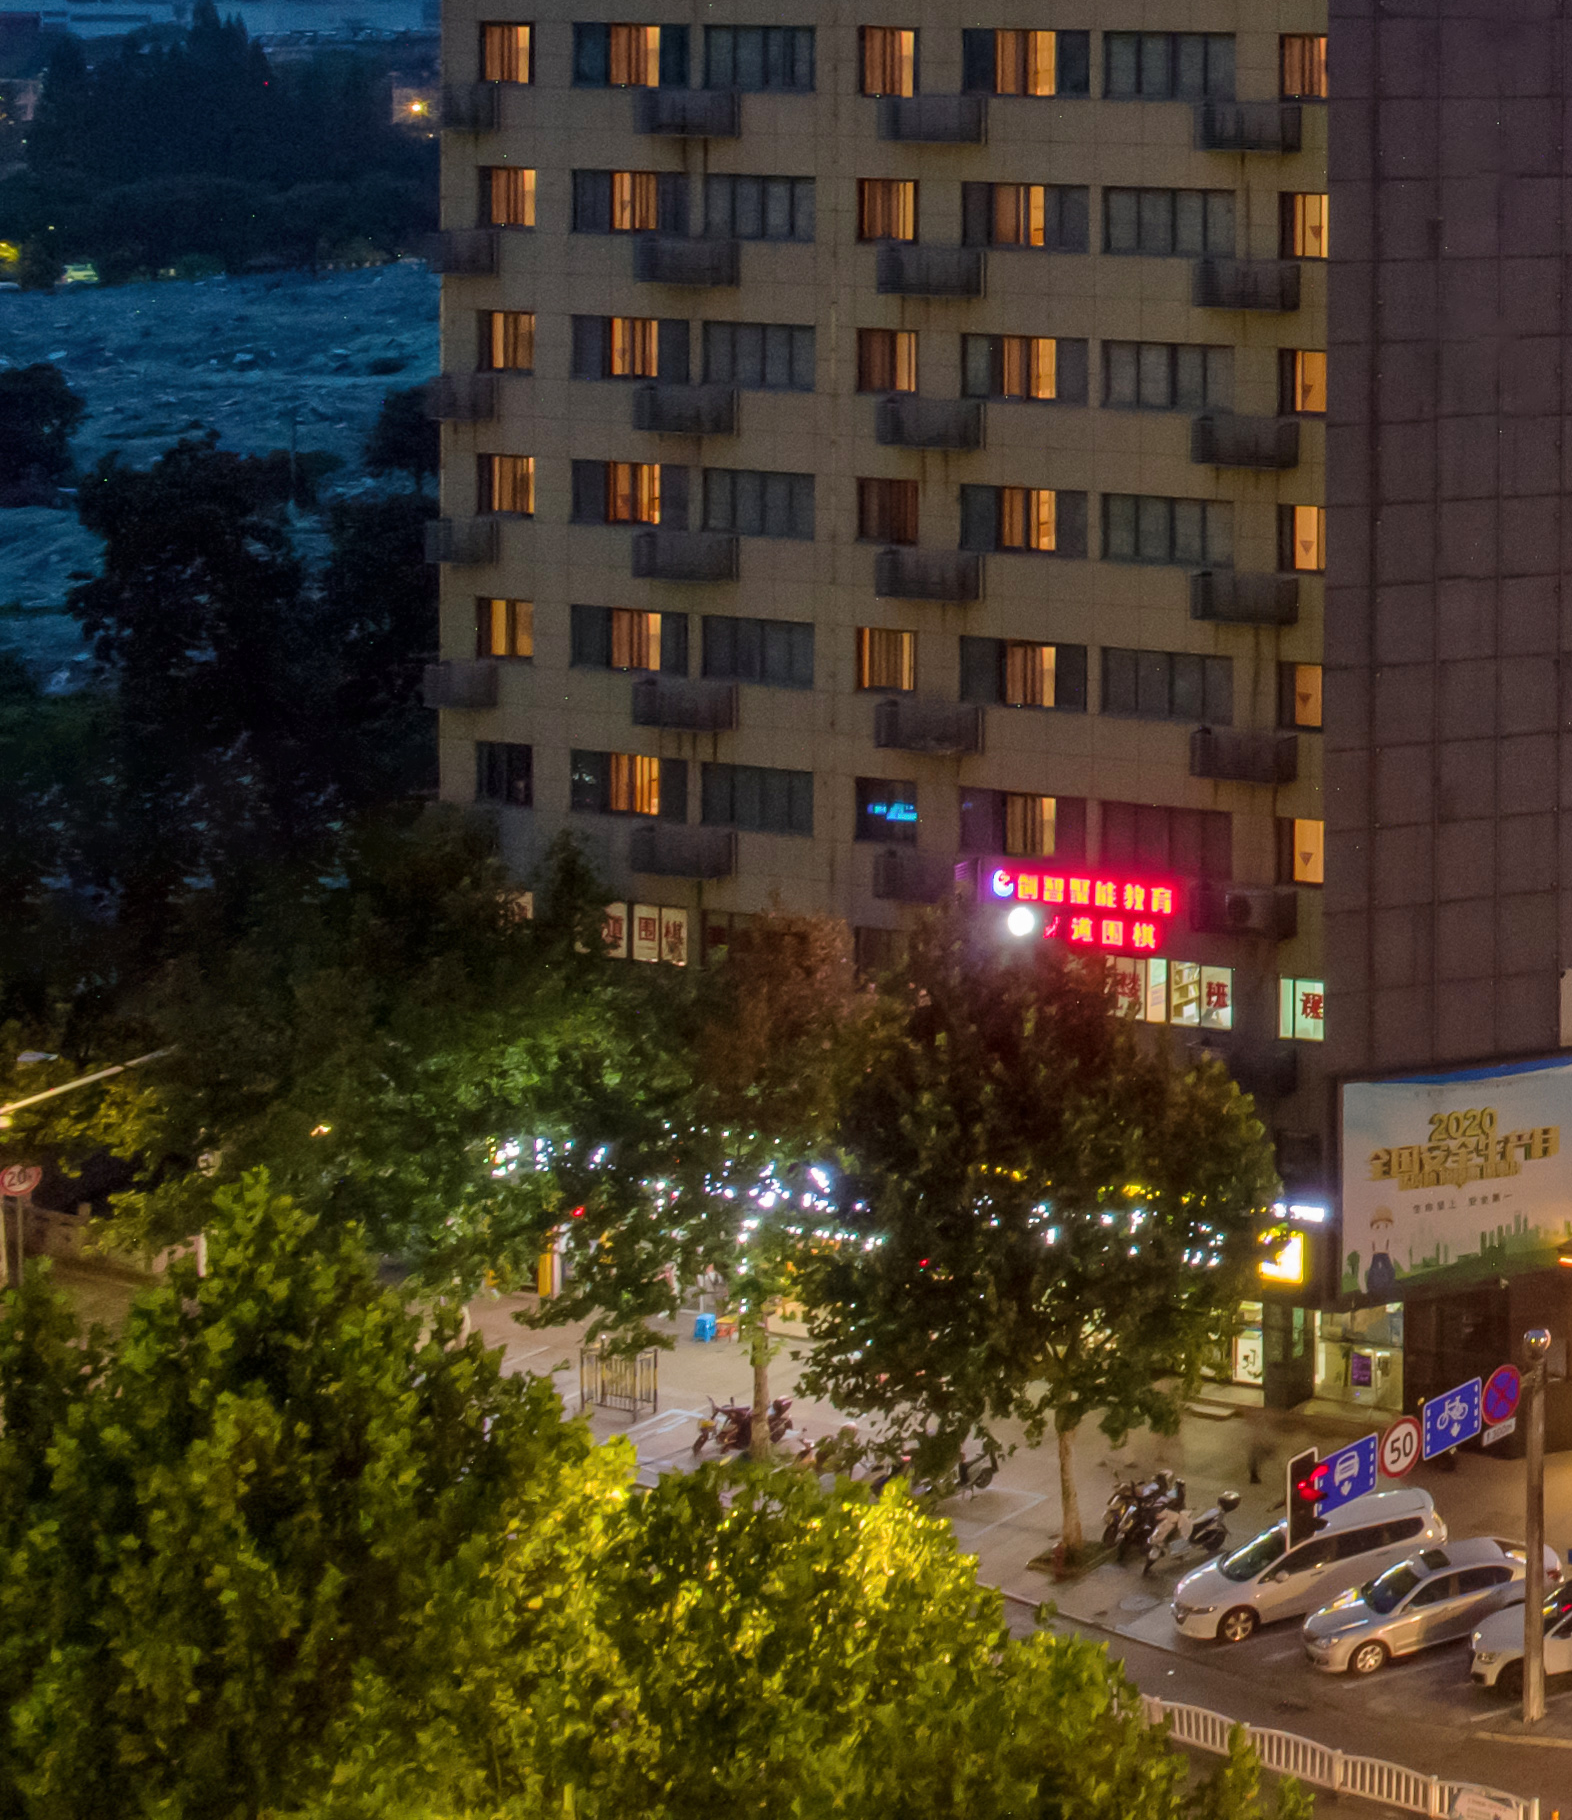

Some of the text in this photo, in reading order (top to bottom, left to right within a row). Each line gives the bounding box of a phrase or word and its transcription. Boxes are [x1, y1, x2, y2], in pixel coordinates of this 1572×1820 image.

[1017, 873, 1173, 914] 创智聚能教育
[1043, 916, 1156, 950] 道围棋
[1428, 1107, 1498, 1142] 2020
[1368, 1126, 1560, 1180] 全国安全生产月
[1388, 1432, 1414, 1464] 50
